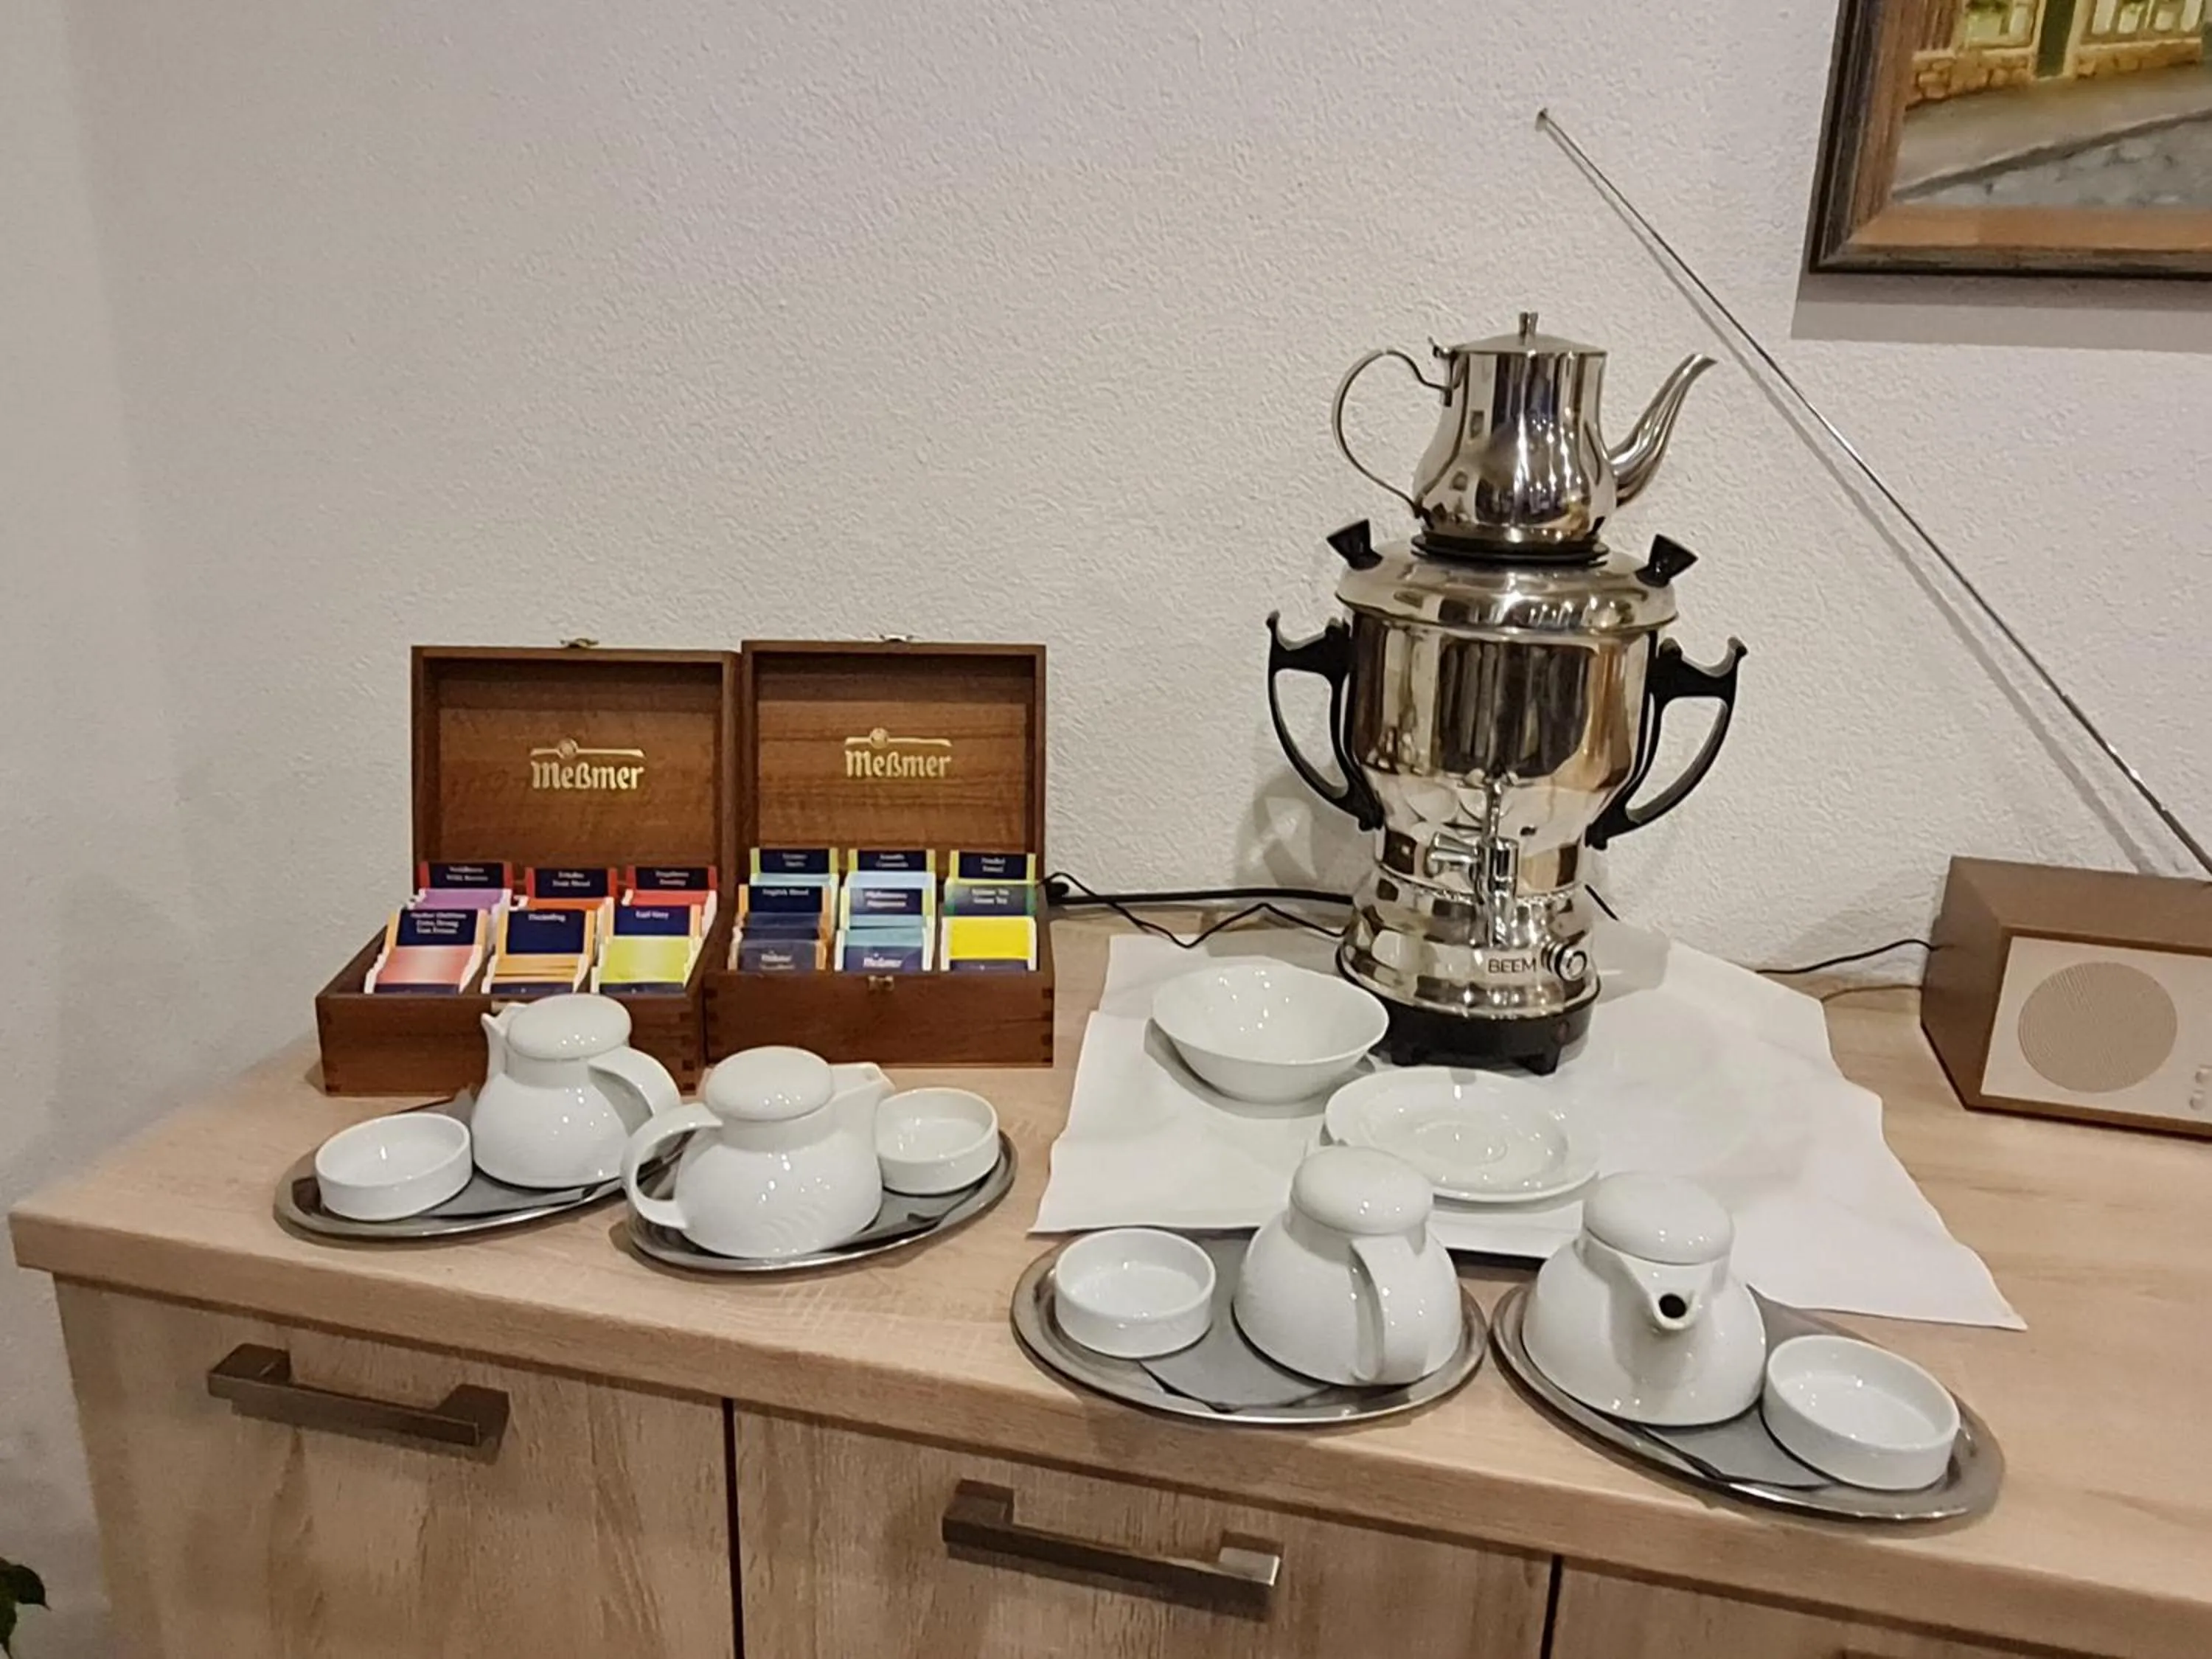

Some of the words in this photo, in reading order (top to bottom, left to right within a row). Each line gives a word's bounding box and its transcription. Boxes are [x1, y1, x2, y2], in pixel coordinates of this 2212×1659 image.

[530, 760, 645, 790] Meßmer
[844, 749, 952, 778] Meßmer
[1488, 958, 1537, 973] BEEM
